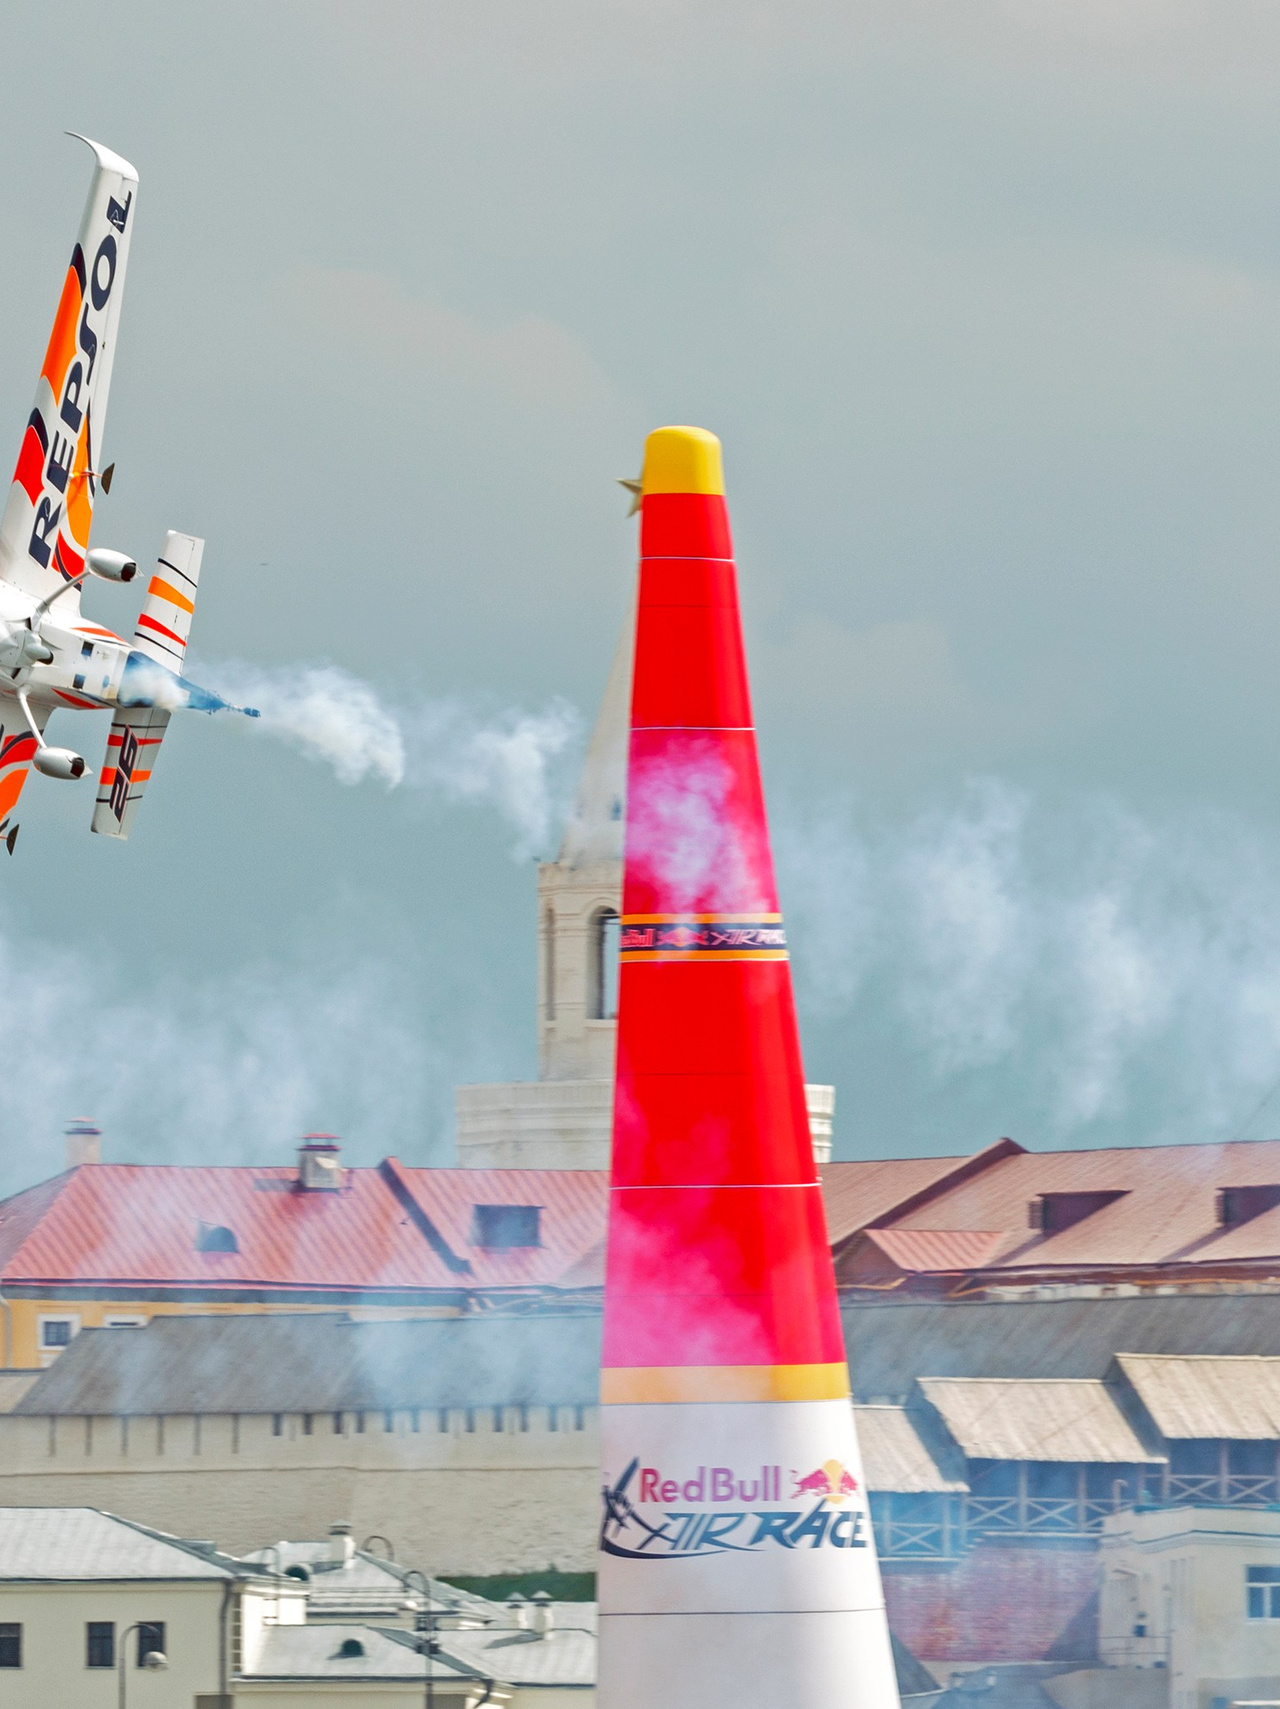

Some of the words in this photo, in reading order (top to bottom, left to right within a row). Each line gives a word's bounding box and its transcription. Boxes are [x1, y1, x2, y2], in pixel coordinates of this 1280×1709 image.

[29, 190, 132, 569] REPSOL
[108, 723, 139, 822] 26
[639, 1466, 706, 1503] Red
[711, 1465, 781, 1501] Bull
[635, 1511, 769, 1551] AIR
[748, 1499, 867, 1549] RACE
